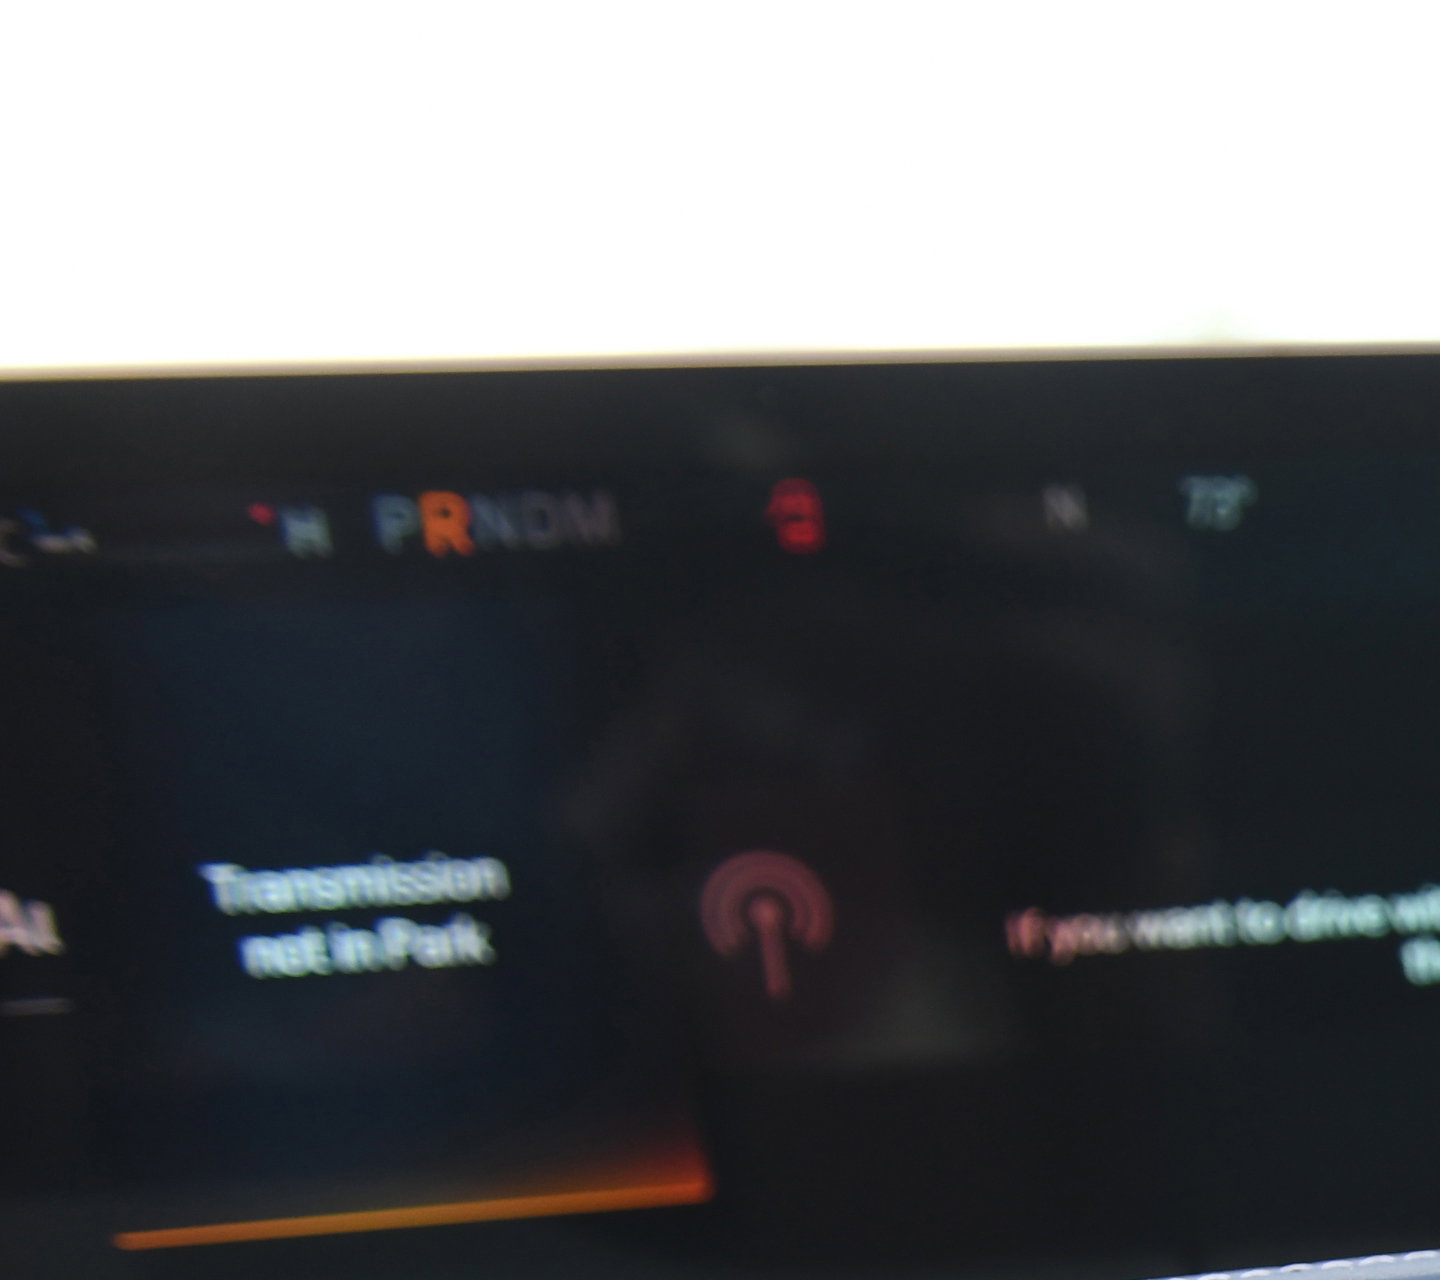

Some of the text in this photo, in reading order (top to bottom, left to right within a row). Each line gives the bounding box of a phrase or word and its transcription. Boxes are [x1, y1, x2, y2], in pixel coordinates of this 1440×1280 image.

[200, 850, 511, 916] Transmission
[238, 913, 496, 979] not in Park
